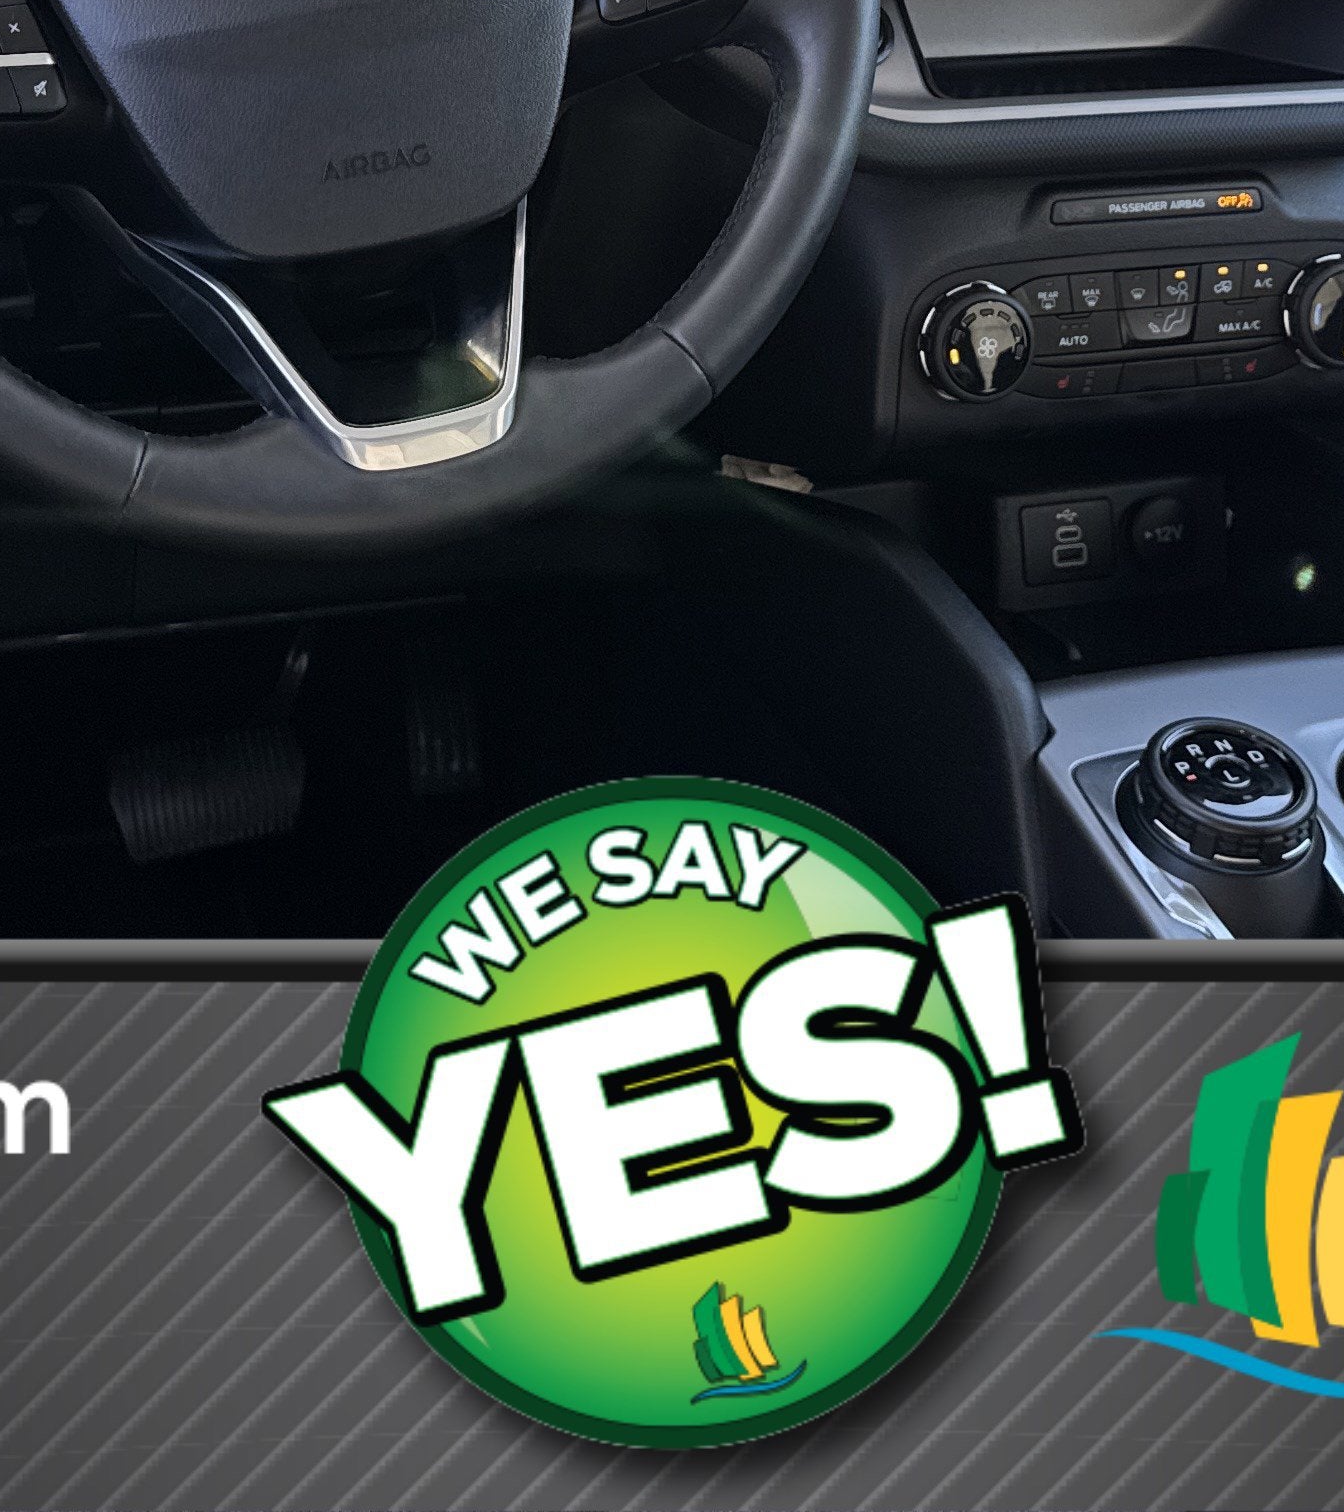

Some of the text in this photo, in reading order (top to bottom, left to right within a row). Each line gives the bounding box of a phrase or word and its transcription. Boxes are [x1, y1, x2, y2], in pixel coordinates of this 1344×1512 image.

[321, 144, 431, 182] AIRBAG
[1108, 195, 1237, 214] PASSENGER AIRBAG OFF
[1254, 277, 1274, 288] A/C
[1037, 290, 1059, 299] REAR
[1218, 320, 1262, 332] MAX A/C
[1059, 335, 1089, 347] AUTO
[1186, 743, 1204, 758] R
[1214, 739, 1233, 752] N
[1247, 750, 1265, 763] D
[1175, 761, 1190, 774] P
[1223, 771, 1240, 782] L
